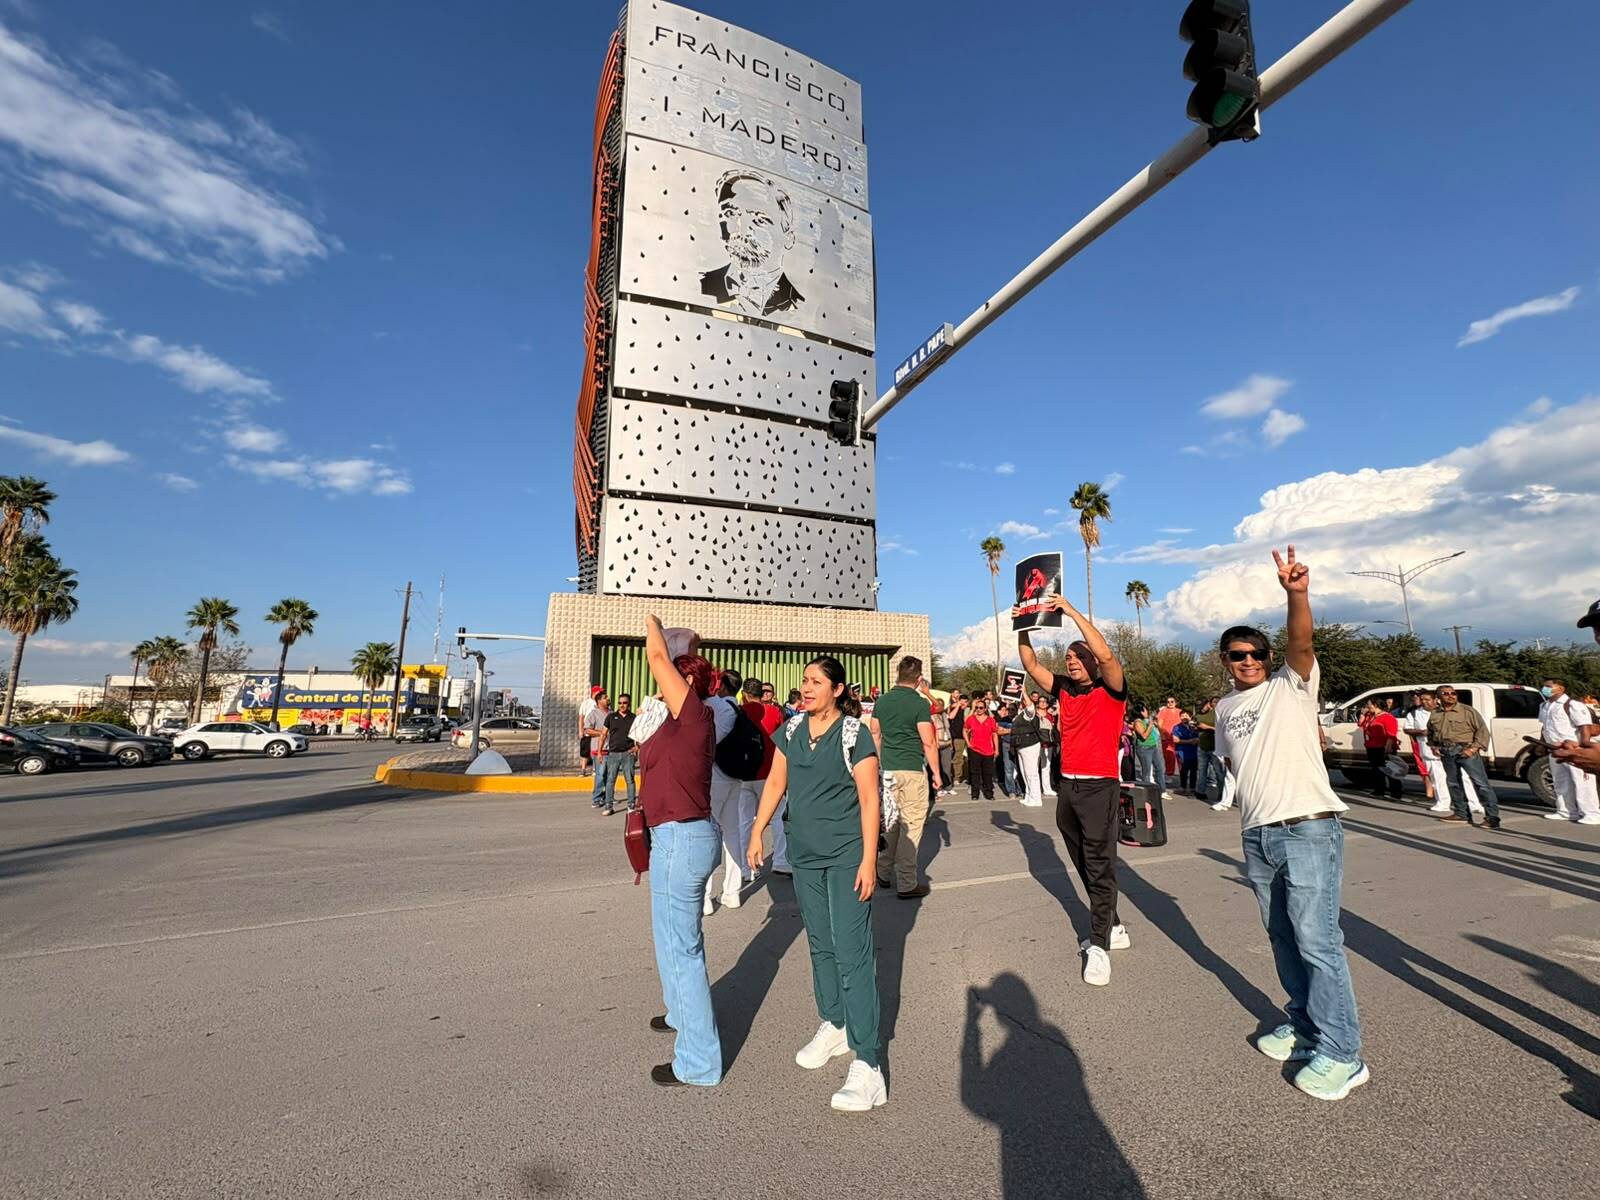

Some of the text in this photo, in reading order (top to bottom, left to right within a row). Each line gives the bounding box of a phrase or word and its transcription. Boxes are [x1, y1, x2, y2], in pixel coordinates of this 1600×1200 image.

[655, 26, 845, 112] FRANCISCO
[703, 107, 842, 172] MADERO
[284, 693, 339, 703] Central
[341, 693, 359, 703] de
[362, 693, 406, 703] Dulcs
